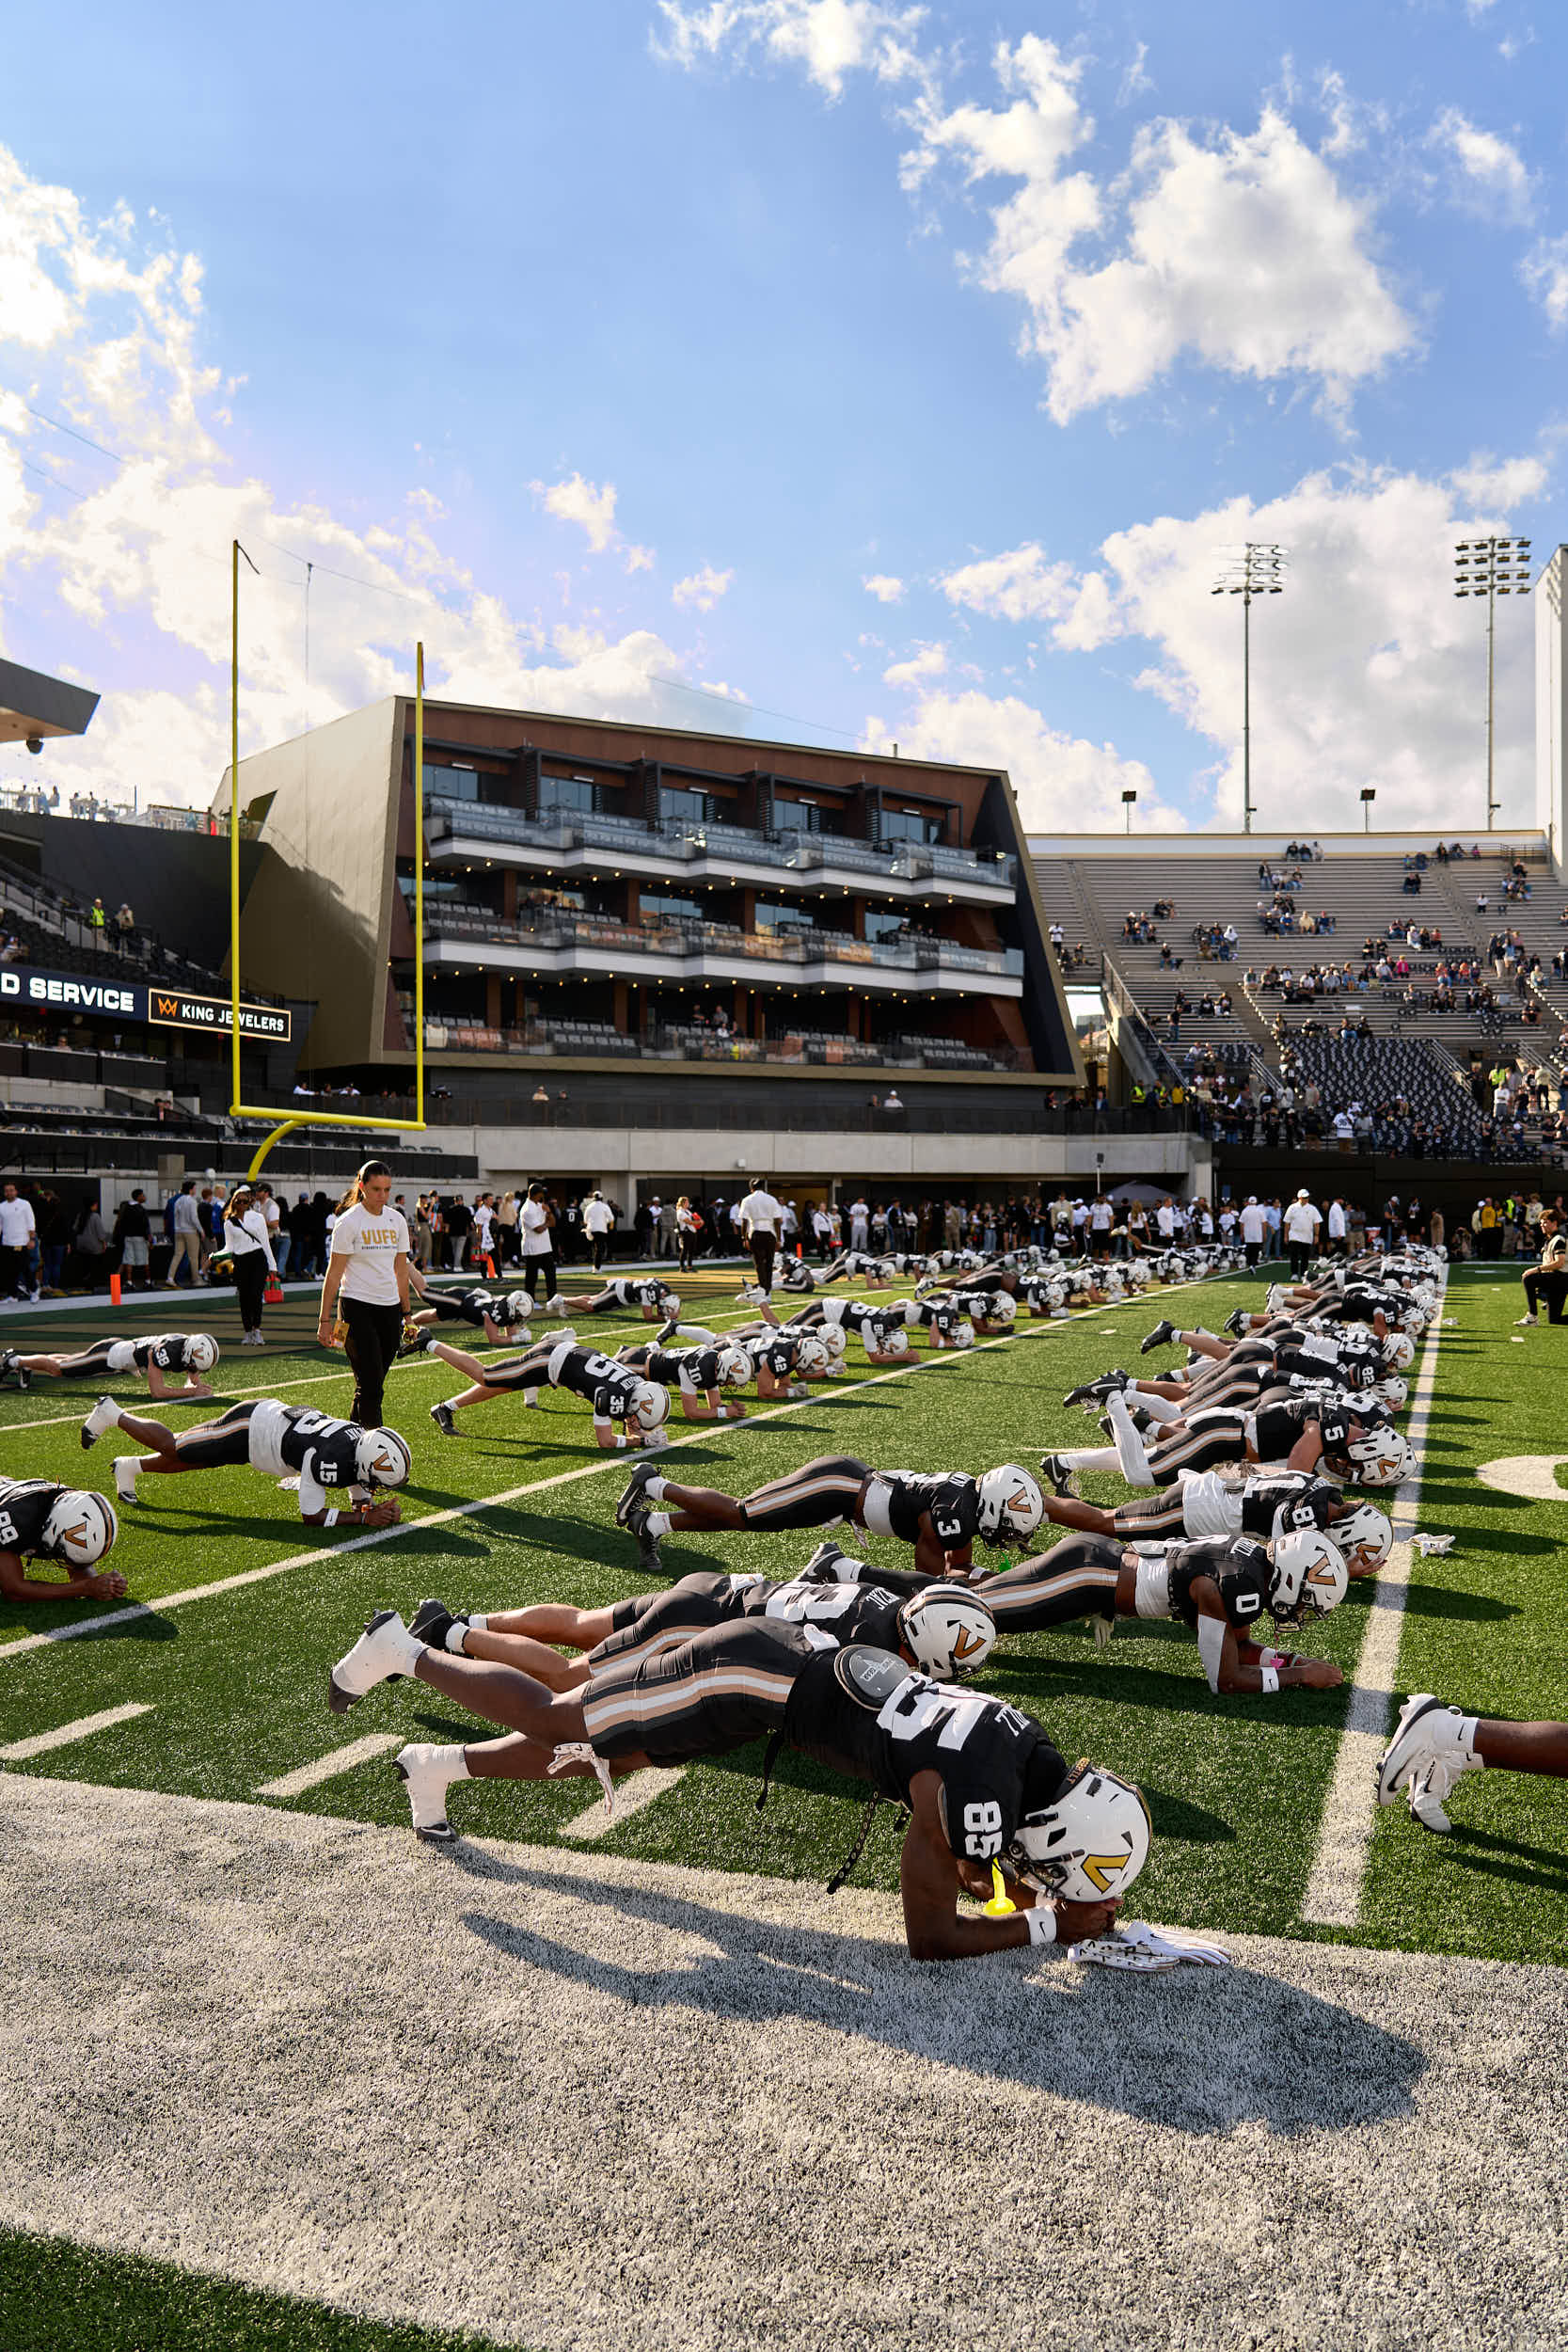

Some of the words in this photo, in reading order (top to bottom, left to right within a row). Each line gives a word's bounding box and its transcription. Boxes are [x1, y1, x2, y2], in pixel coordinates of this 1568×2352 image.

[29, 977, 135, 1012] SERVICE
[182, 1004, 214, 1022] KING
[1385, 1311, 1395, 1323] 16
[773, 1354, 788, 1373] 42
[688, 1365, 703, 1384] 10
[1361, 1366, 1376, 1385] 82
[610, 1395, 625, 1415] 35
[1324, 1424, 1345, 1441] 5
[372, 1451, 394, 1472] V
[320, 1461, 338, 1484] 15
[1007, 1486, 1033, 1514] V
[64, 1521, 87, 1549] V
[938, 1518, 961, 1536] 3
[1307, 1551, 1337, 1587] V
[1236, 1593, 1260, 1613] 0
[953, 1623, 987, 1660] V
[963, 1801, 1003, 1859] 85
[1081, 1851, 1132, 1895] V
